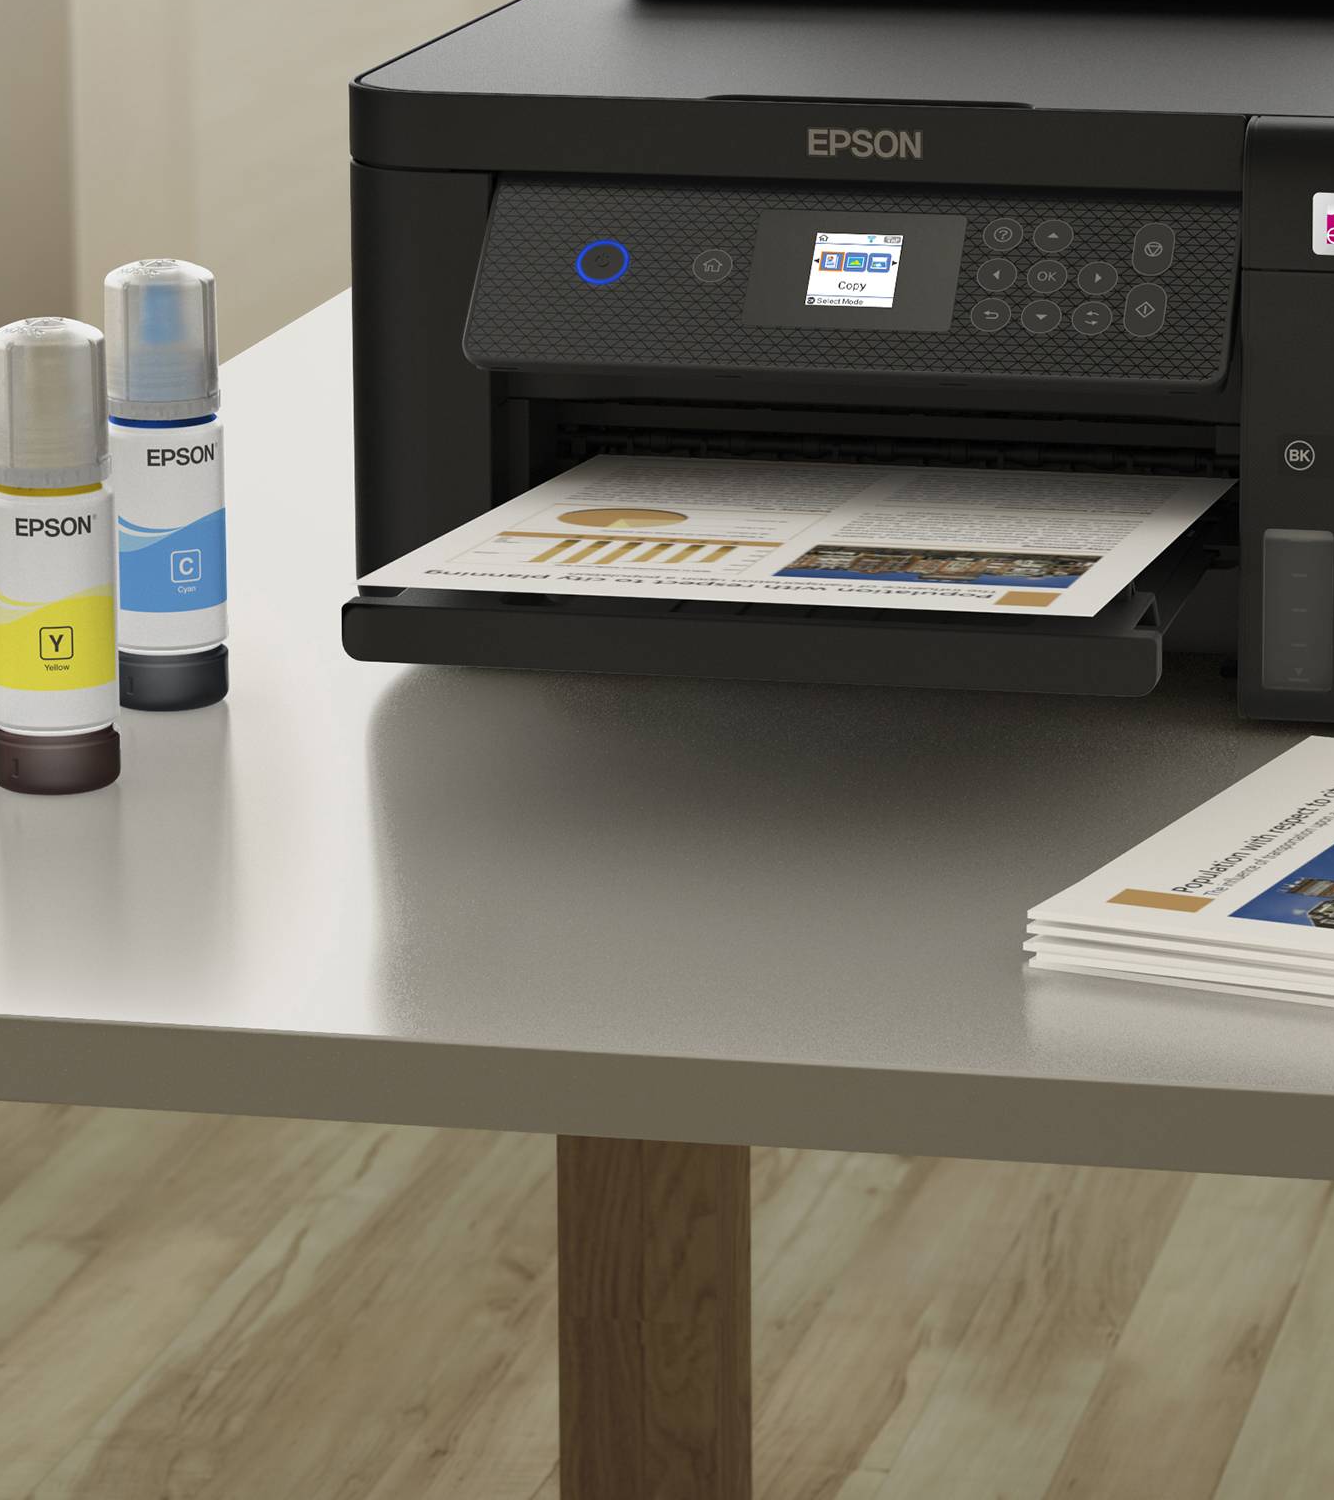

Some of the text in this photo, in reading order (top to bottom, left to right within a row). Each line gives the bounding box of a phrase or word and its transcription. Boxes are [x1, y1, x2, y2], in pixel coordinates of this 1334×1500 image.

[807, 127, 923, 158] EPSON
[1037, 270, 1057, 283] OK
[838, 281, 867, 292] Copy
[816, 297, 864, 306] Select Mode
[1289, 448, 1311, 462] BK
[179, 557, 194, 575] C
[178, 585, 196, 594] Cyan
[49, 634, 64, 652] Y
[44, 663, 70, 671] Yellow
[1171, 851, 1250, 894] Population
[1240, 834, 1278, 851] with
[1268, 807, 1319, 833] respect
[1305, 798, 1331, 807] to
